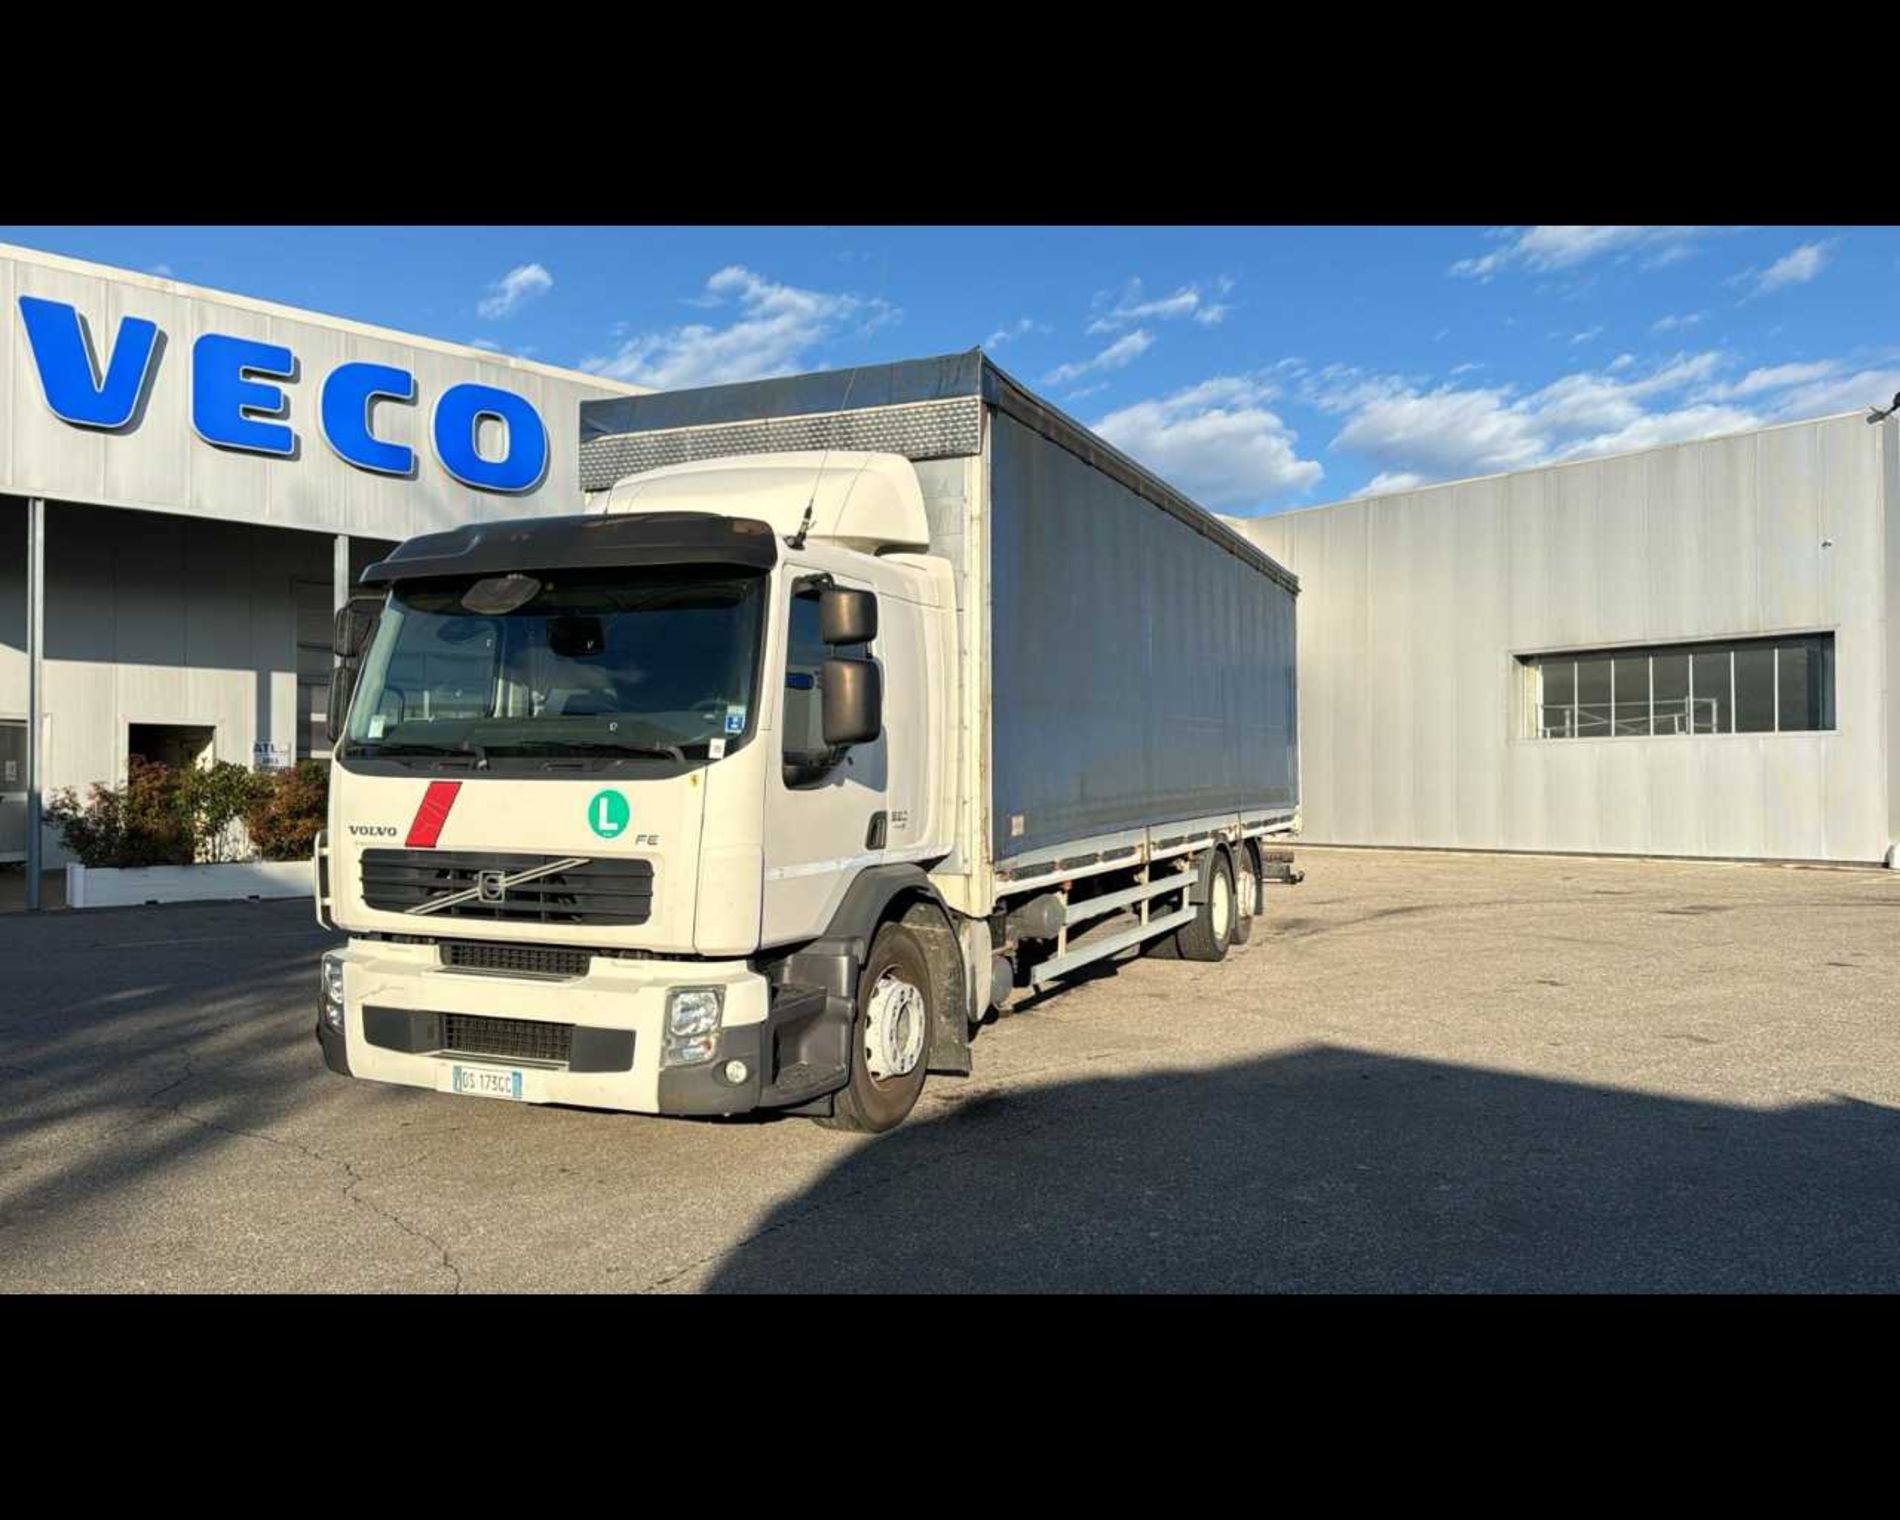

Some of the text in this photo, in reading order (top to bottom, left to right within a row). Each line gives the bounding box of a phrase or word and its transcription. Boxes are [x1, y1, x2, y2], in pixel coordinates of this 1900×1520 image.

[18, 294, 549, 492] VECO
[599, 797, 618, 830] L
[349, 825, 397, 837] VOLVO
[635, 834, 659, 846] FE
